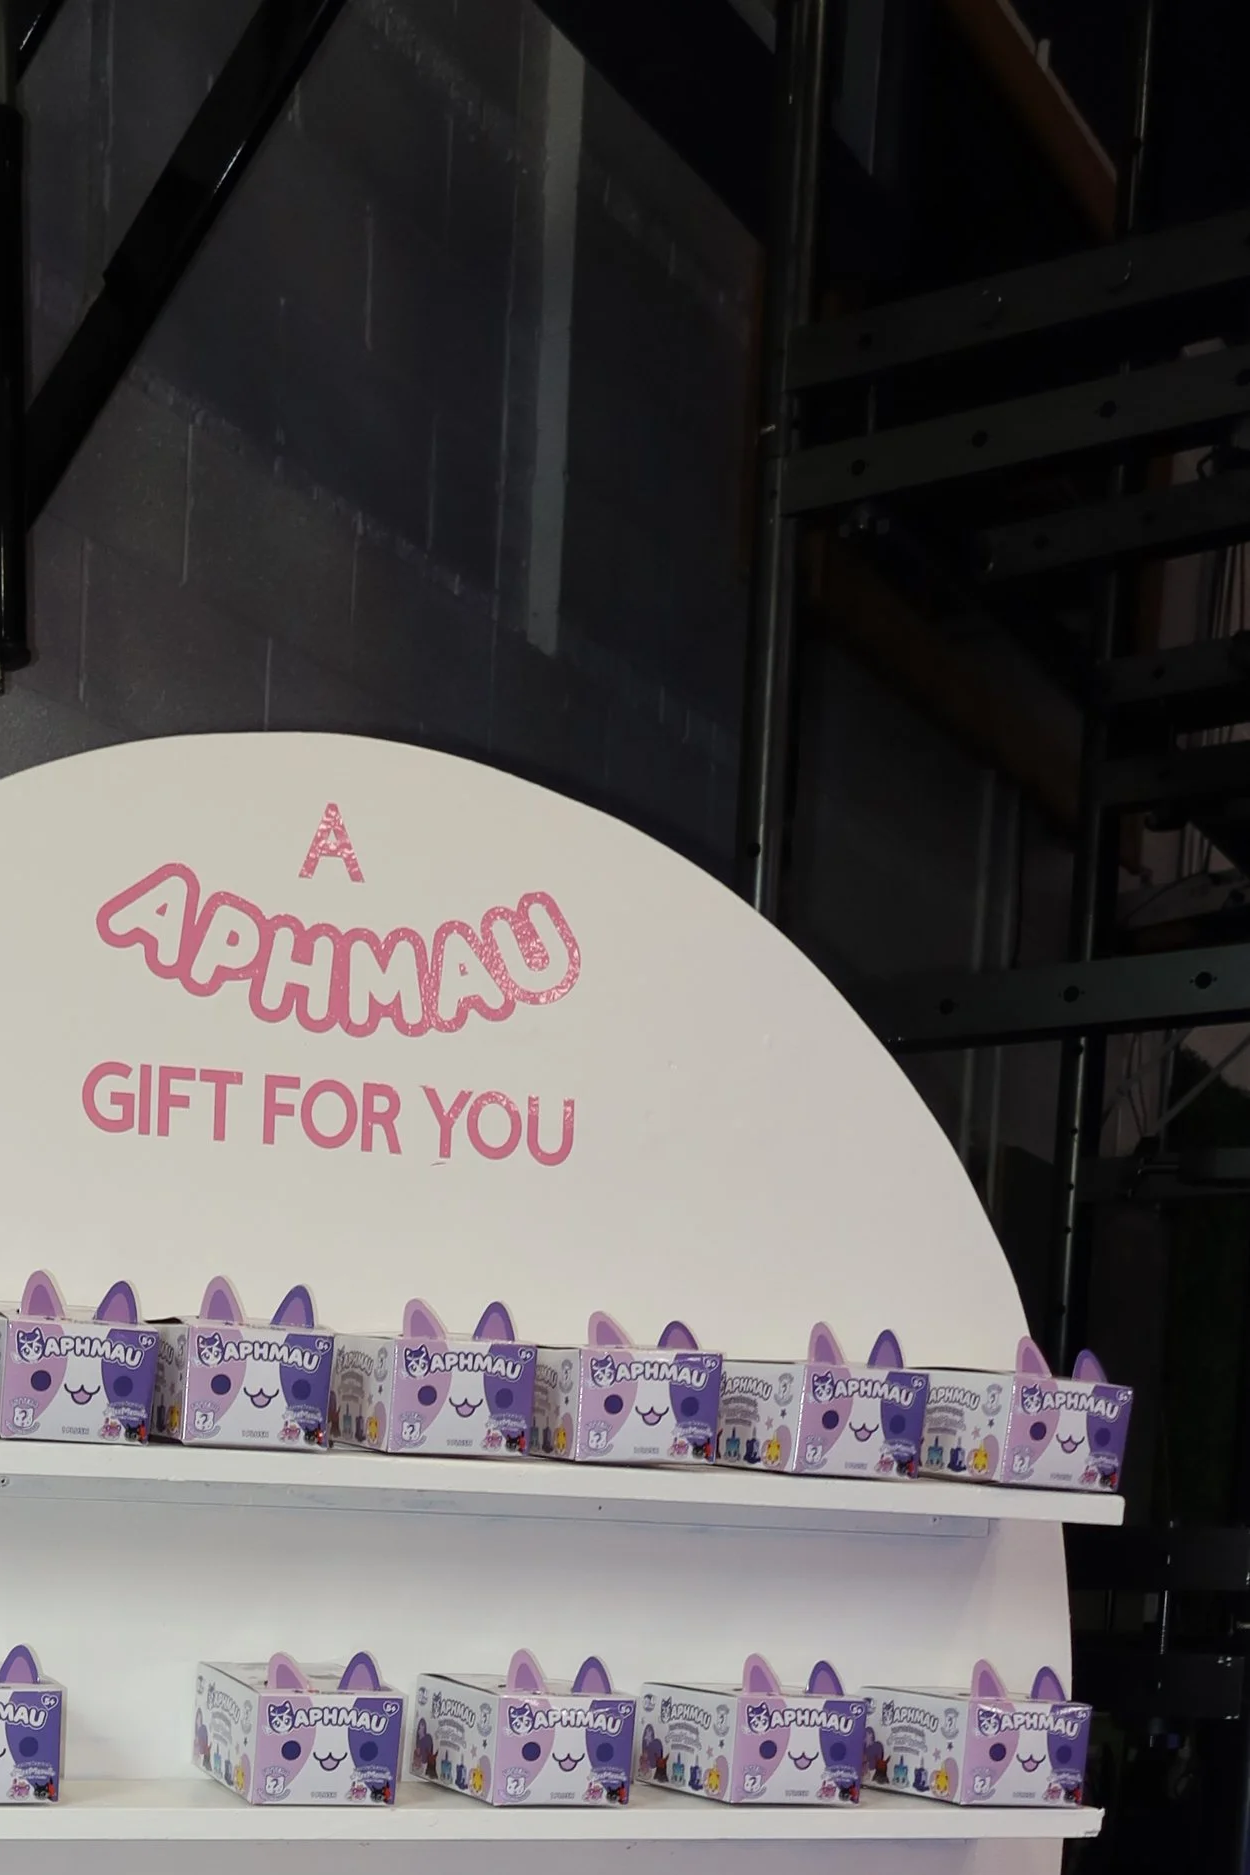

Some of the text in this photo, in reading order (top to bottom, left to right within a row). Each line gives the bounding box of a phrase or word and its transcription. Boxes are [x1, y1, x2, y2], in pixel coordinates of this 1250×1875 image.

[298, 803, 366, 883] A
[96, 862, 582, 1037] APHMAU
[82, 1061, 575, 1166] GIFT FOR YOU
[45, 1336, 143, 1366] APHMAU
[224, 1340, 319, 1371] APHMAU
[430, 1352, 521, 1381] APHMAU
[615, 1361, 707, 1388] APHMAU
[725, 1372, 772, 1400] APHMAU
[834, 1379, 914, 1407] APHMAU
[1042, 1392, 1119, 1419] APHMAU
[293, 1706, 388, 1732] APHMAU
[532, 1710, 622, 1735] APHMAU
[670, 1705, 712, 1729] APHMAU
[771, 1708, 854, 1734] APHMAU
[893, 1707, 939, 1733] APHMAU
[1000, 1710, 1079, 1738] APHMAU
